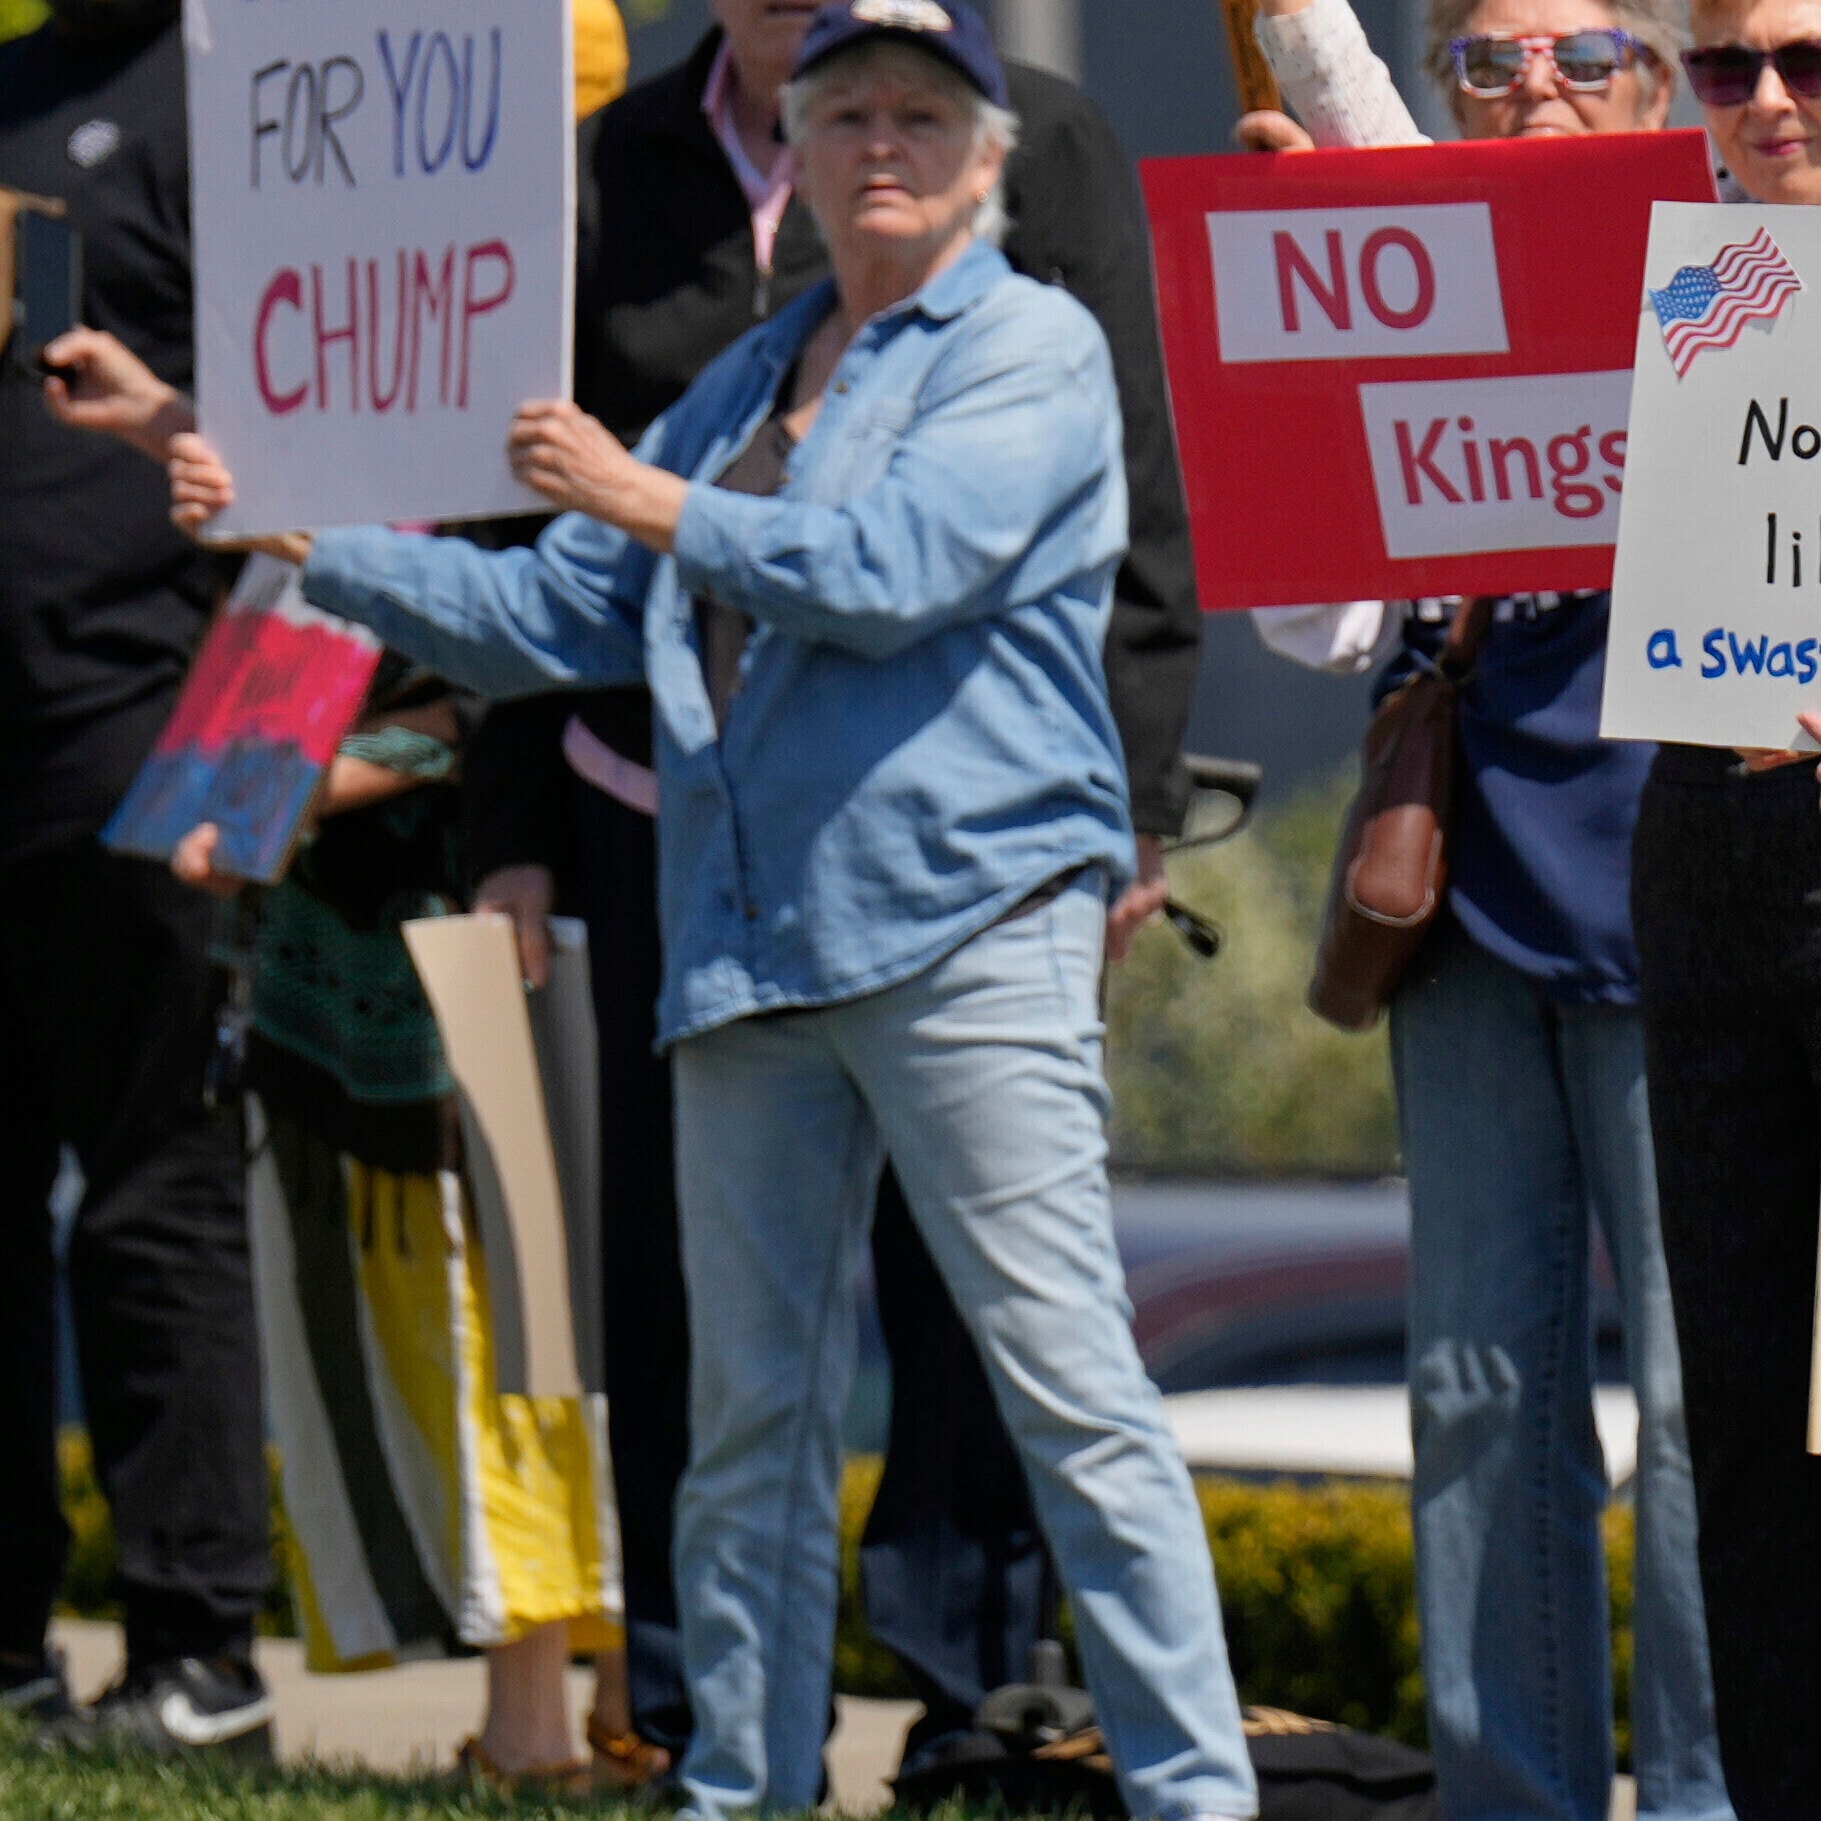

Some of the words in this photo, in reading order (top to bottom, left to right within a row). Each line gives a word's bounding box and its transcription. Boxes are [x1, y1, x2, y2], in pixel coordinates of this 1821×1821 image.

[248, 55, 367, 189] FOR
[377, 26, 502, 176] YOU
[253, 237, 517, 416] CHUMP
[1273, 225, 1436, 333] NO
[1646, 627, 1682, 669] a
